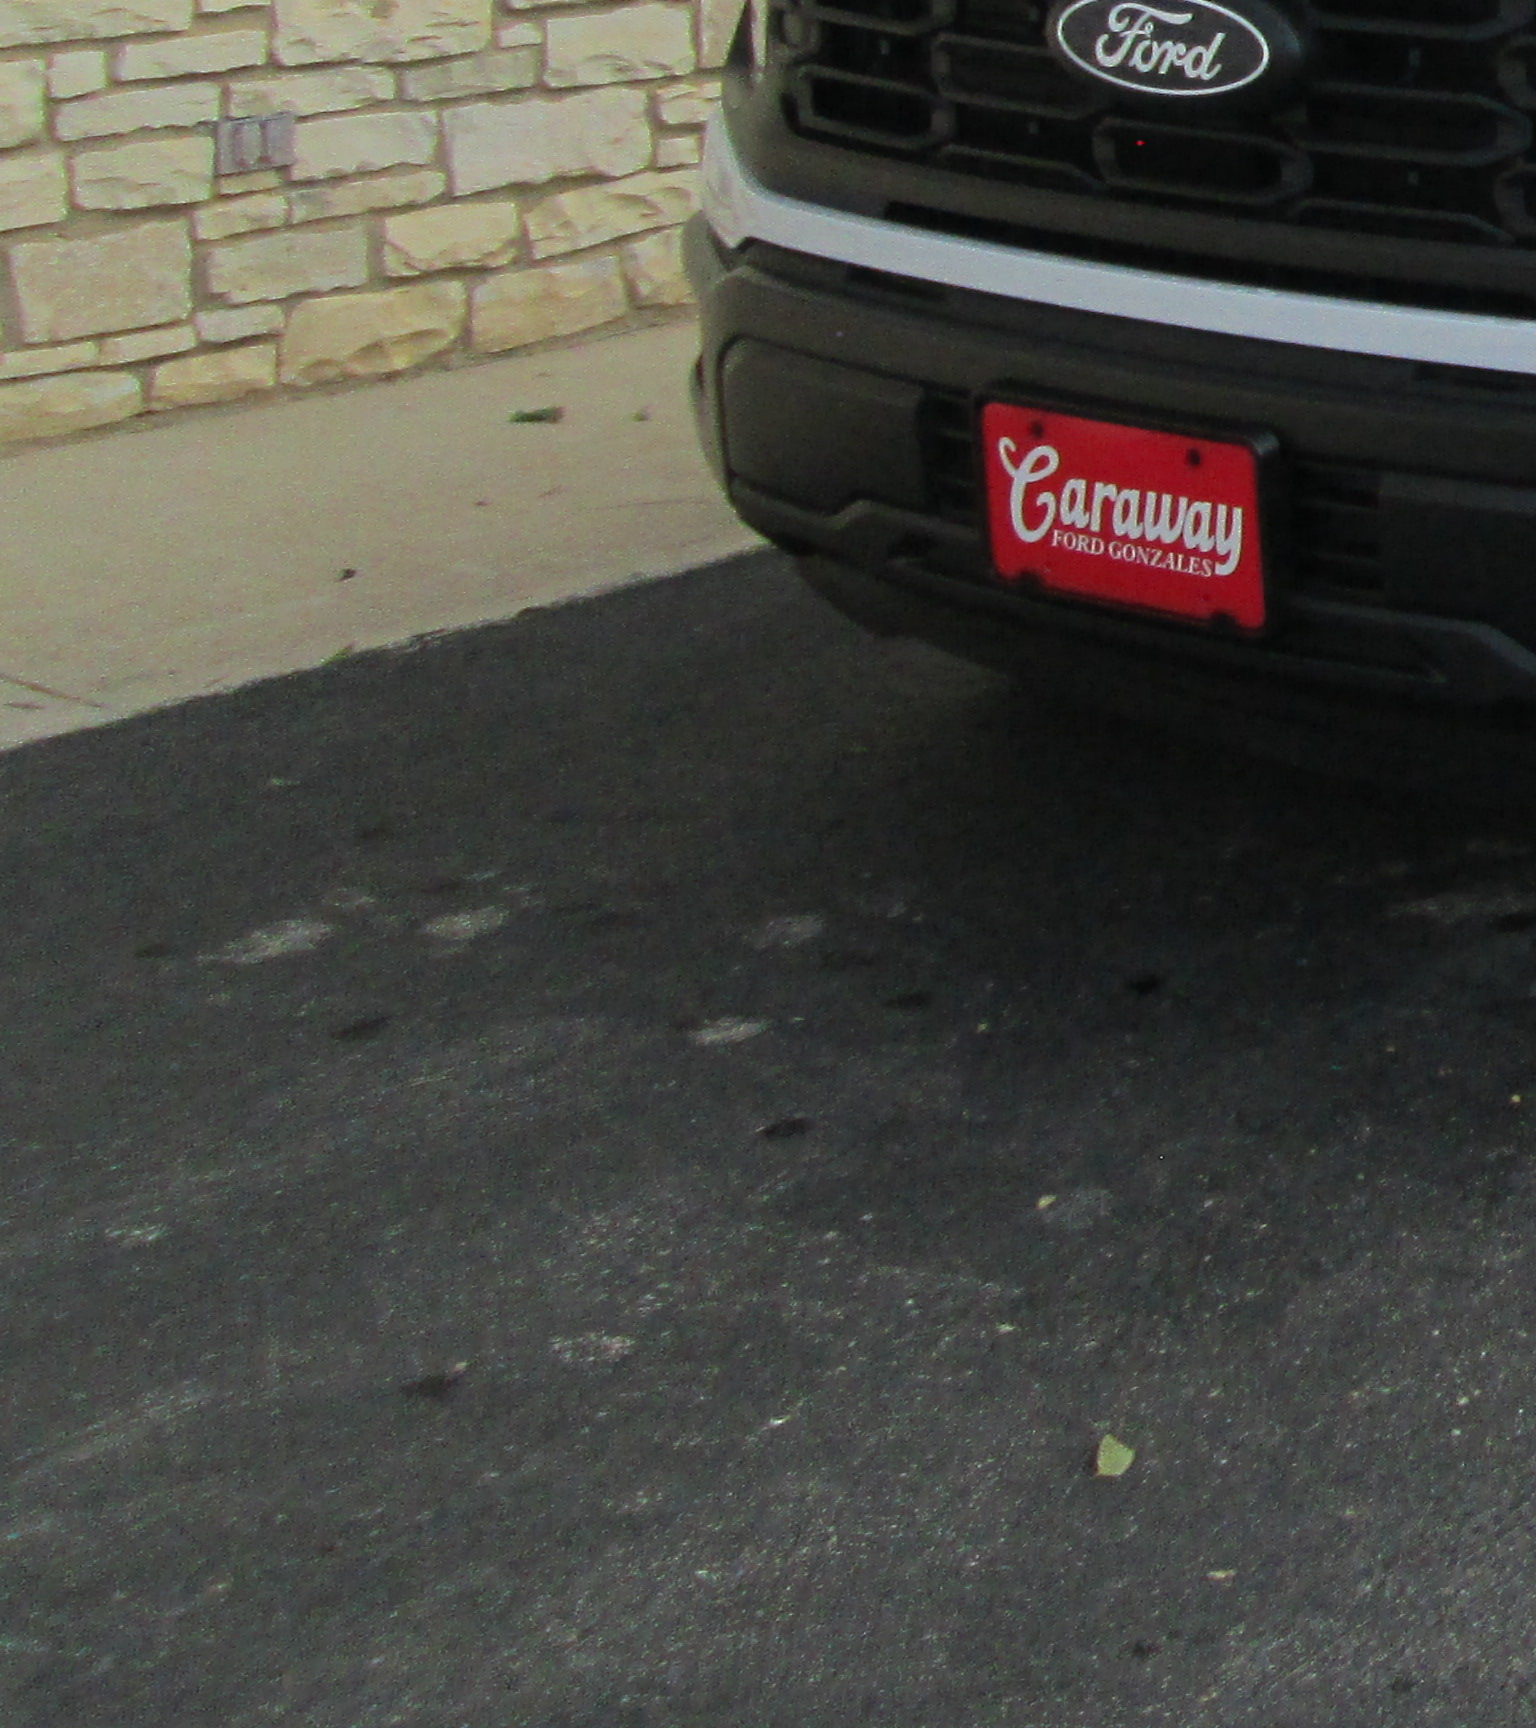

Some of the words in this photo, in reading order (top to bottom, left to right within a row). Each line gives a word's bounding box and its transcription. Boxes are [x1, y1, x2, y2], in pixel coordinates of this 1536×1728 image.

[1095, 2, 1226, 81] Ford
[998, 436, 1243, 576] Caraway
[1051, 529, 1105, 556] FORD
[1108, 540, 1213, 578] GONZALES
